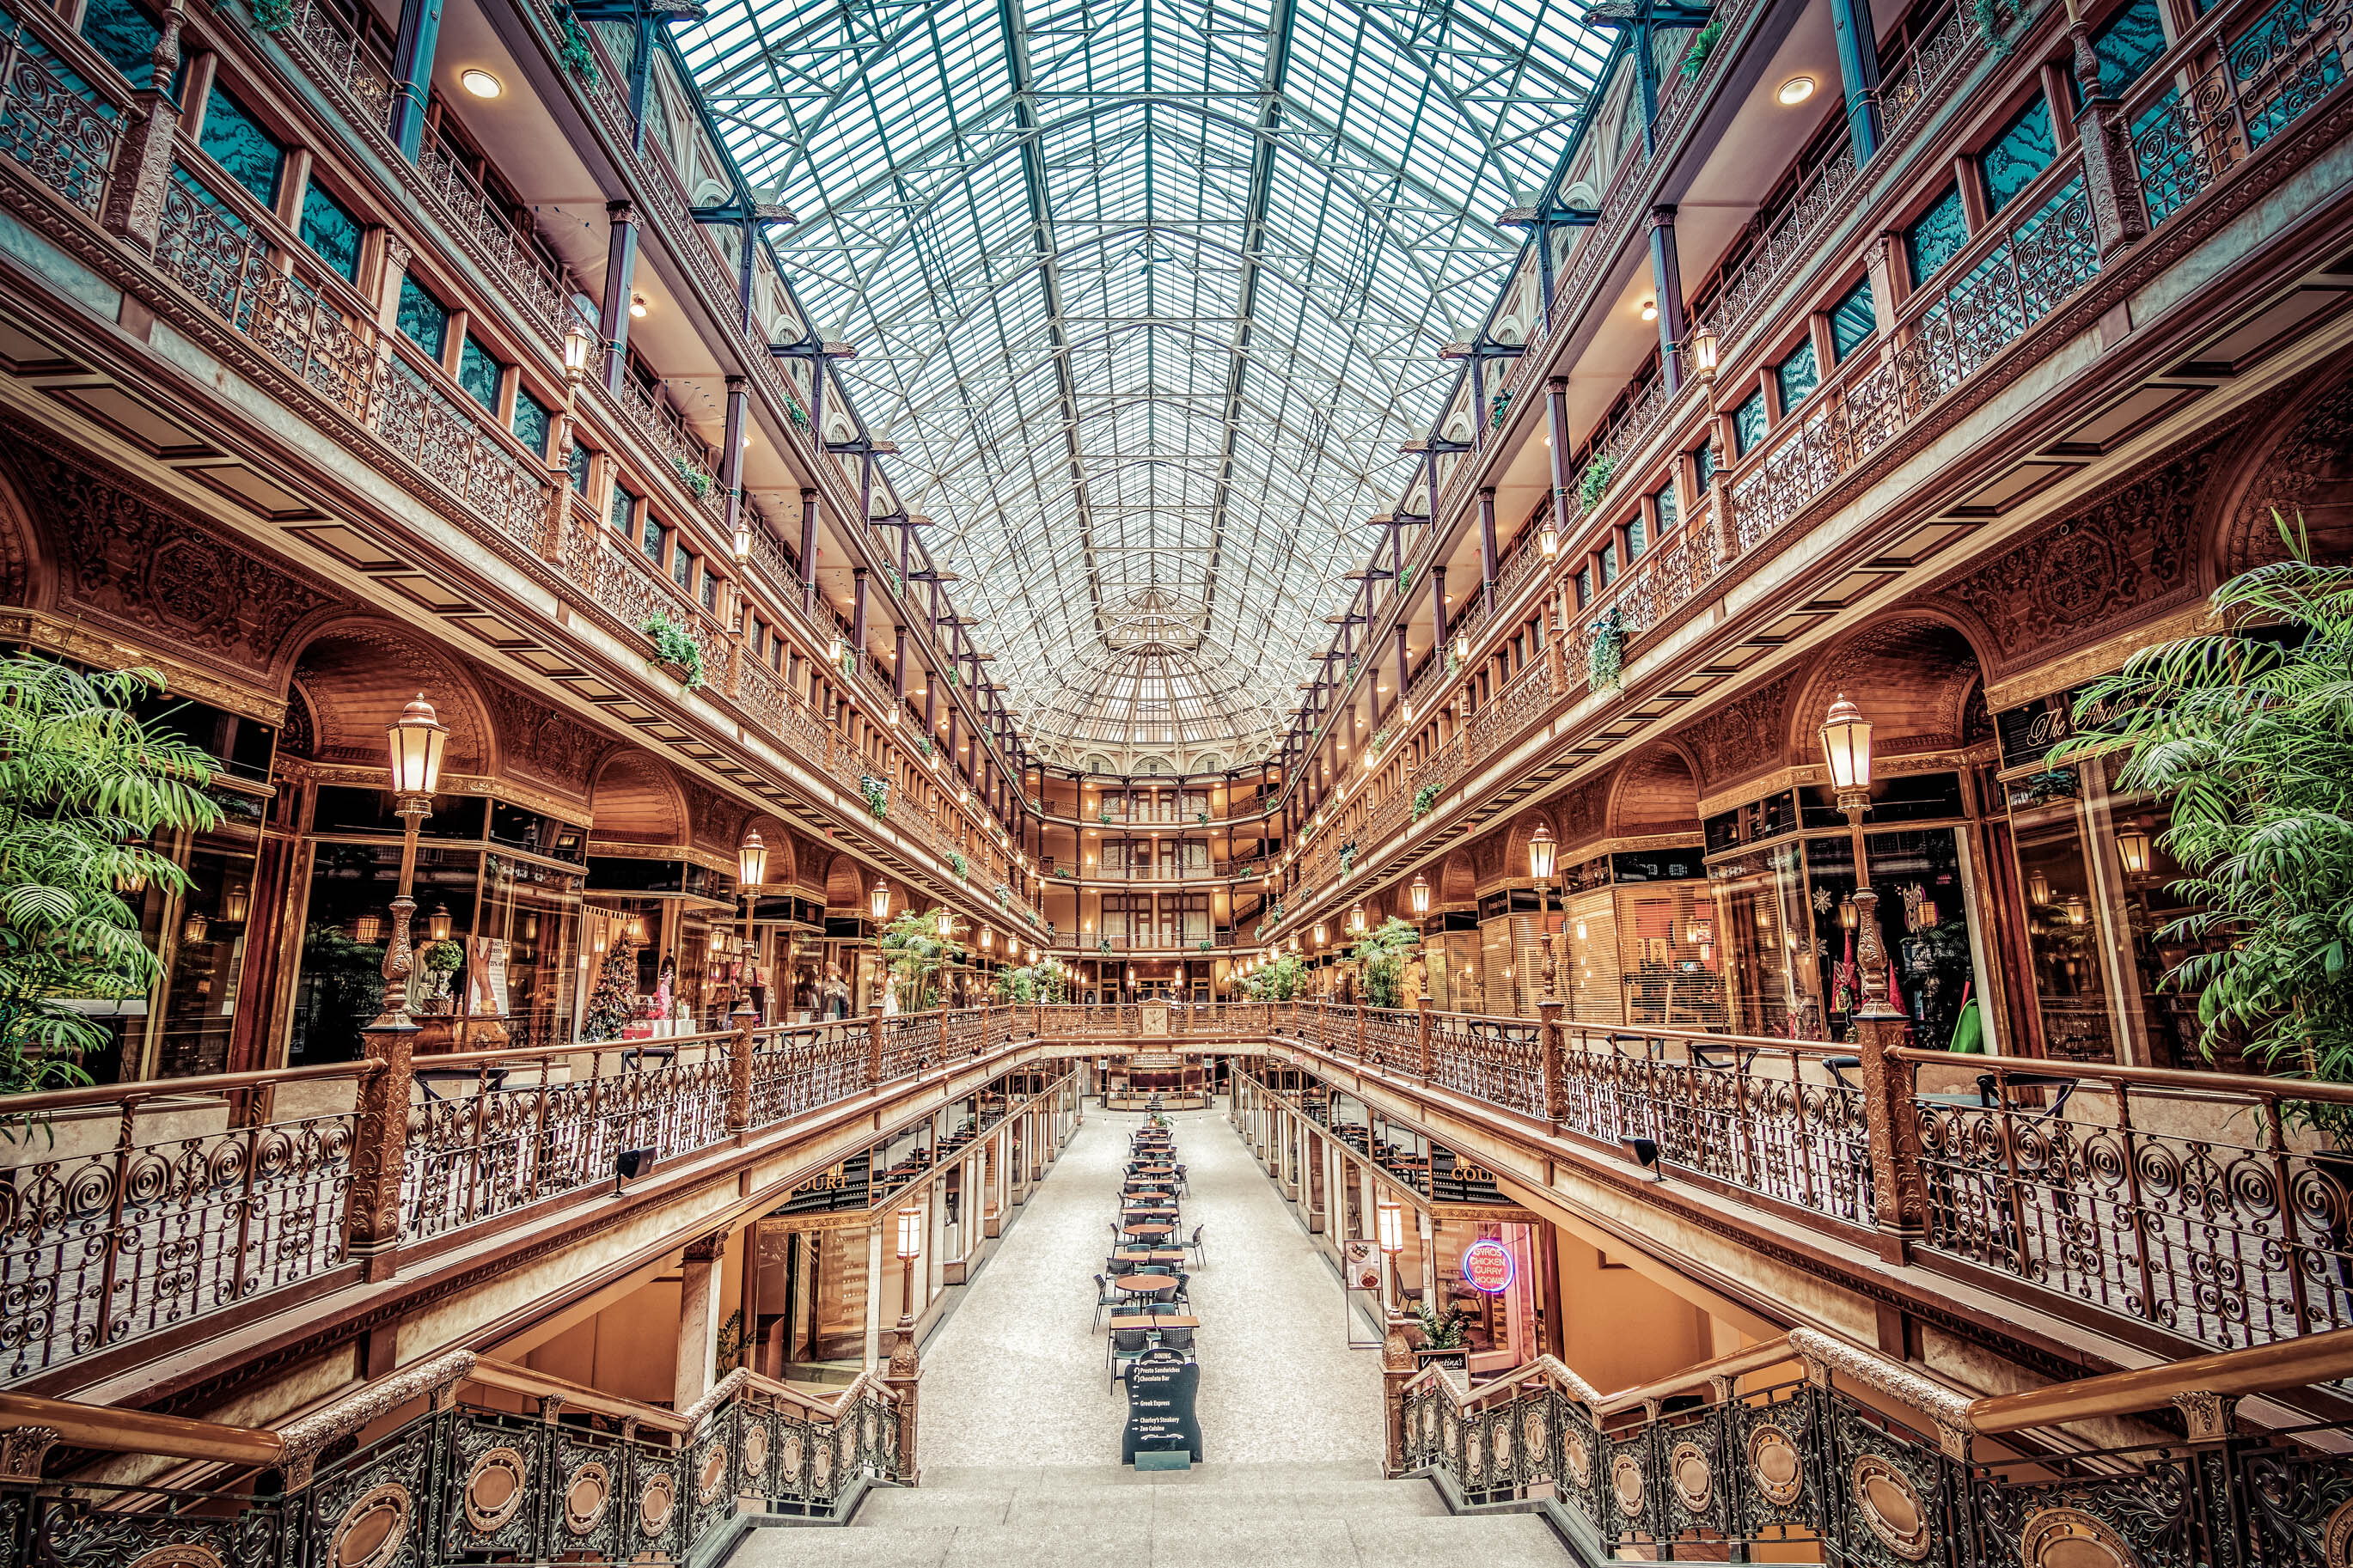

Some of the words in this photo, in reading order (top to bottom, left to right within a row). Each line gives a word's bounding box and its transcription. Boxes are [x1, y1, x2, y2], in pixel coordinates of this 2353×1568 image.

[2026, 707, 2067, 747] The
[798, 1174, 850, 1192] OURT
[1474, 1248, 1502, 1257] GYROS
[1470, 1257, 1506, 1266] CHICKEN
[1475, 1266, 1502, 1275] CURRY
